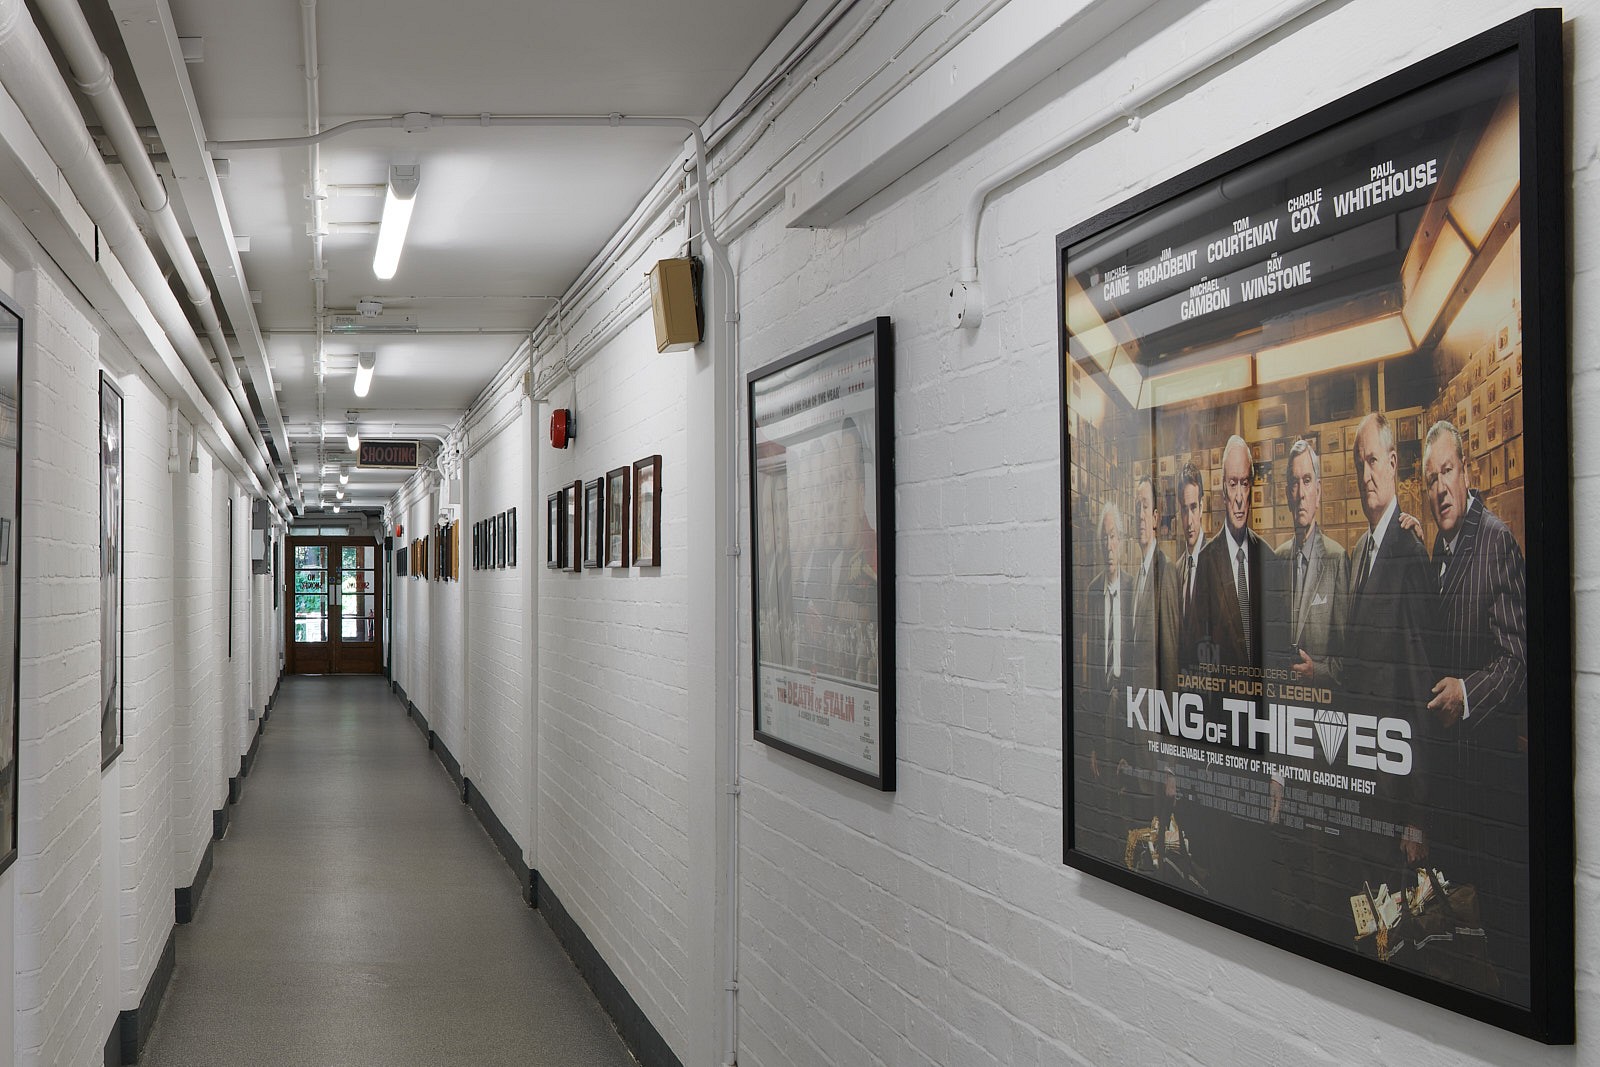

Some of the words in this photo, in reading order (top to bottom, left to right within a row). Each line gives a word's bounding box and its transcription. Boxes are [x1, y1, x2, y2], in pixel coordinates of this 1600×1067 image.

[1370, 160, 1395, 181] PAUL
[1287, 188, 1322, 213] CHARLIE
[1333, 159, 1438, 218] WHITEHOUSE
[1232, 217, 1250, 232] TOM
[1291, 204, 1320, 233] COX
[1207, 219, 1278, 263] COURTENAY
[1160, 248, 1172, 262] JIM
[1267, 257, 1282, 274] RAY
[1104, 265, 1128, 283] MICHAEL
[1137, 250, 1198, 289] BROADBENT
[1241, 261, 1312, 302] WINSTONE
[1103, 277, 1130, 302] CAINE
[1189, 279, 1219, 299] MICHAEL
[1181, 288, 1230, 321] GAMBON
[362, 446, 415, 462] SHOOTING
[1199, 662, 1220, 673] FROM
[1220, 665, 1236, 675] THE
[1238, 665, 1287, 680] PRODUCERS
[1290, 670, 1302, 681] OF
[1177, 674, 1225, 693] DARKEST
[1229, 679, 1263, 697] HOUR
[1266, 682, 1276, 698] &
[1279, 686, 1332, 704] LEGEND
[1126, 685, 1204, 741] KING
[1205, 722, 1227, 744] OF
[1147, 740, 1159, 753] THE
[1160, 742, 1205, 762] UNBELIEVABLE
[1206, 751, 1224, 766] TRUE
[1225, 755, 1249, 771] STORY
[1250, 759, 1261, 773] OF
[1262, 762, 1277, 776] THE
[1278, 765, 1311, 784] HATTON
[1312, 770, 1349, 790] GARDEN
[1350, 778, 1376, 796] HEIST
